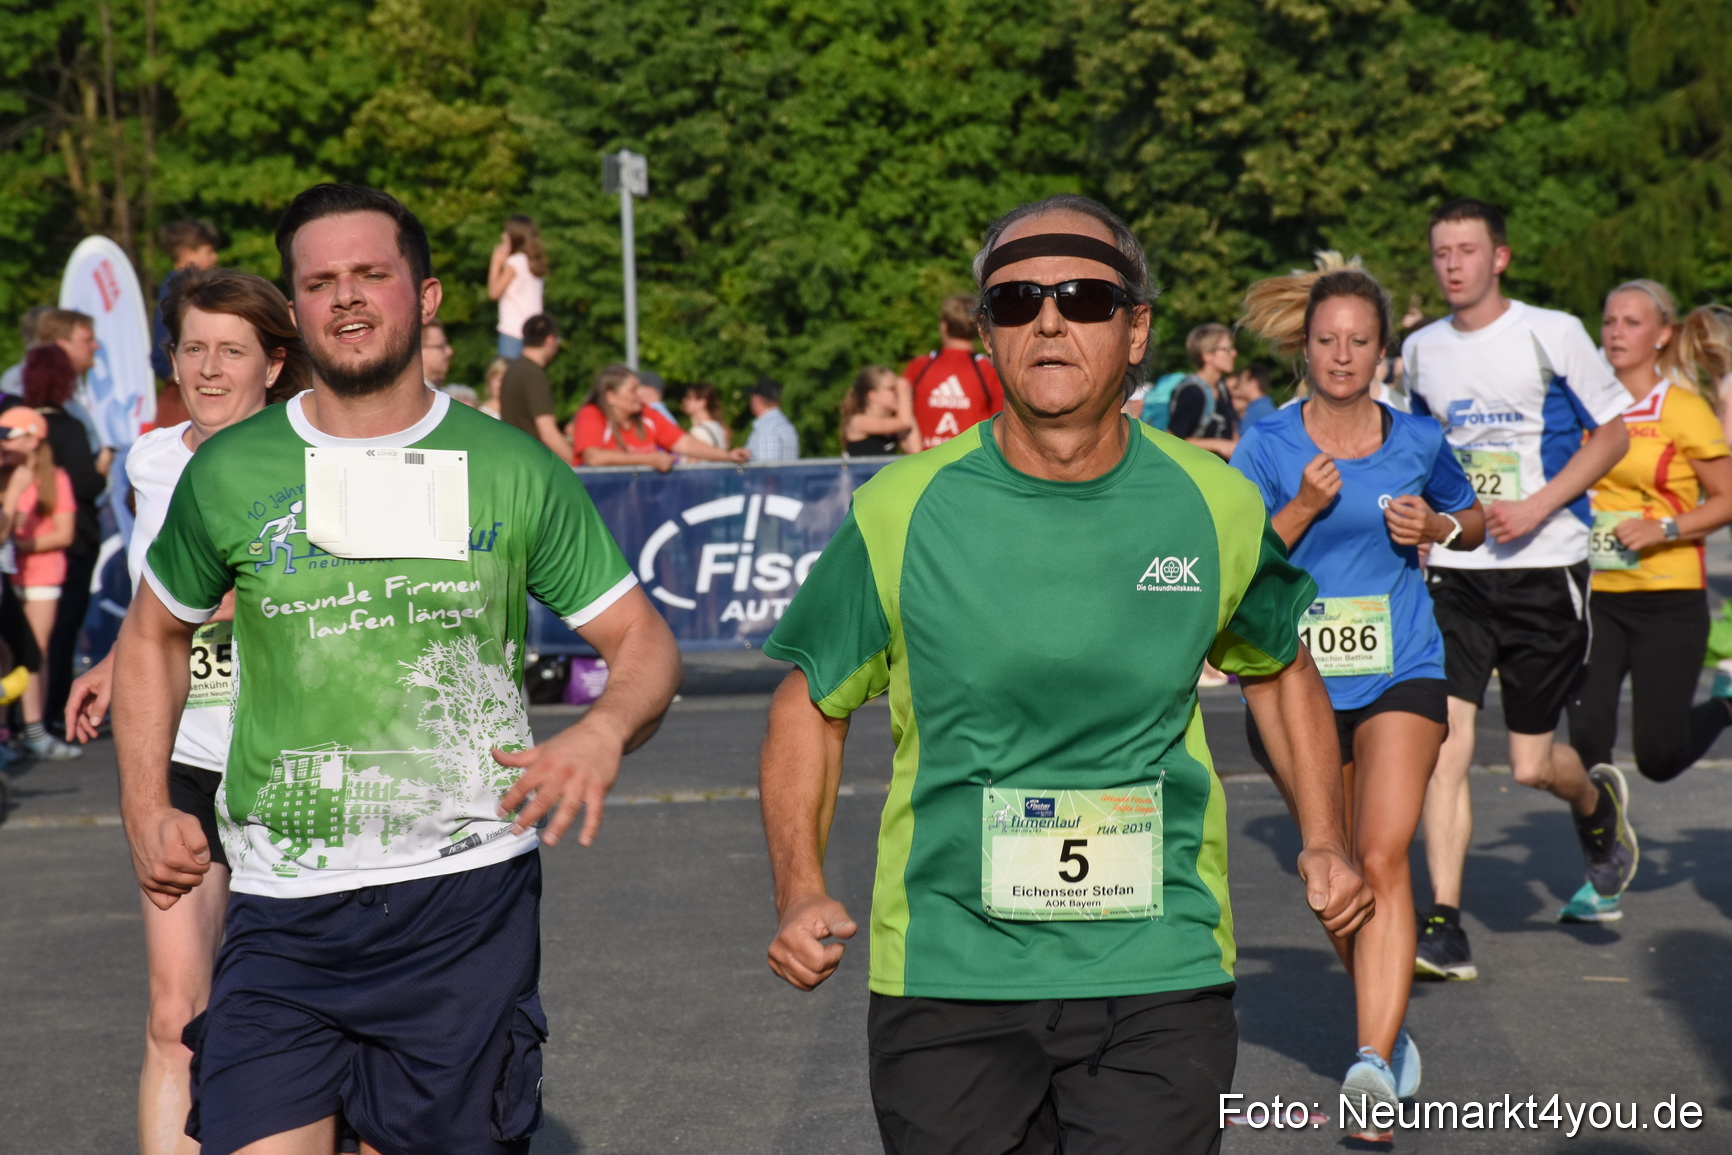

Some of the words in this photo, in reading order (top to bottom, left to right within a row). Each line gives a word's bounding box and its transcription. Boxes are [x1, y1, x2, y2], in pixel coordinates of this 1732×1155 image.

[1628, 427, 1660, 438] ÖGL
[247, 501, 266, 520] 10
[1139, 556, 1200, 584] AOK
[261, 581, 373, 618] Gesunde
[385, 575, 481, 599] Firmen
[309, 609, 395, 640] laufen
[1300, 625, 1377, 654] 1086
[1011, 815, 1082, 828] firmenlauf
[1122, 821, 1152, 834] 2019
[1058, 839, 1090, 883] 5
[1012, 885, 1088, 897] Eichenseer
[1092, 884, 1134, 896] Stefan
[1045, 900, 1066, 908] AOK
[1069, 900, 1101, 909] Bayern
